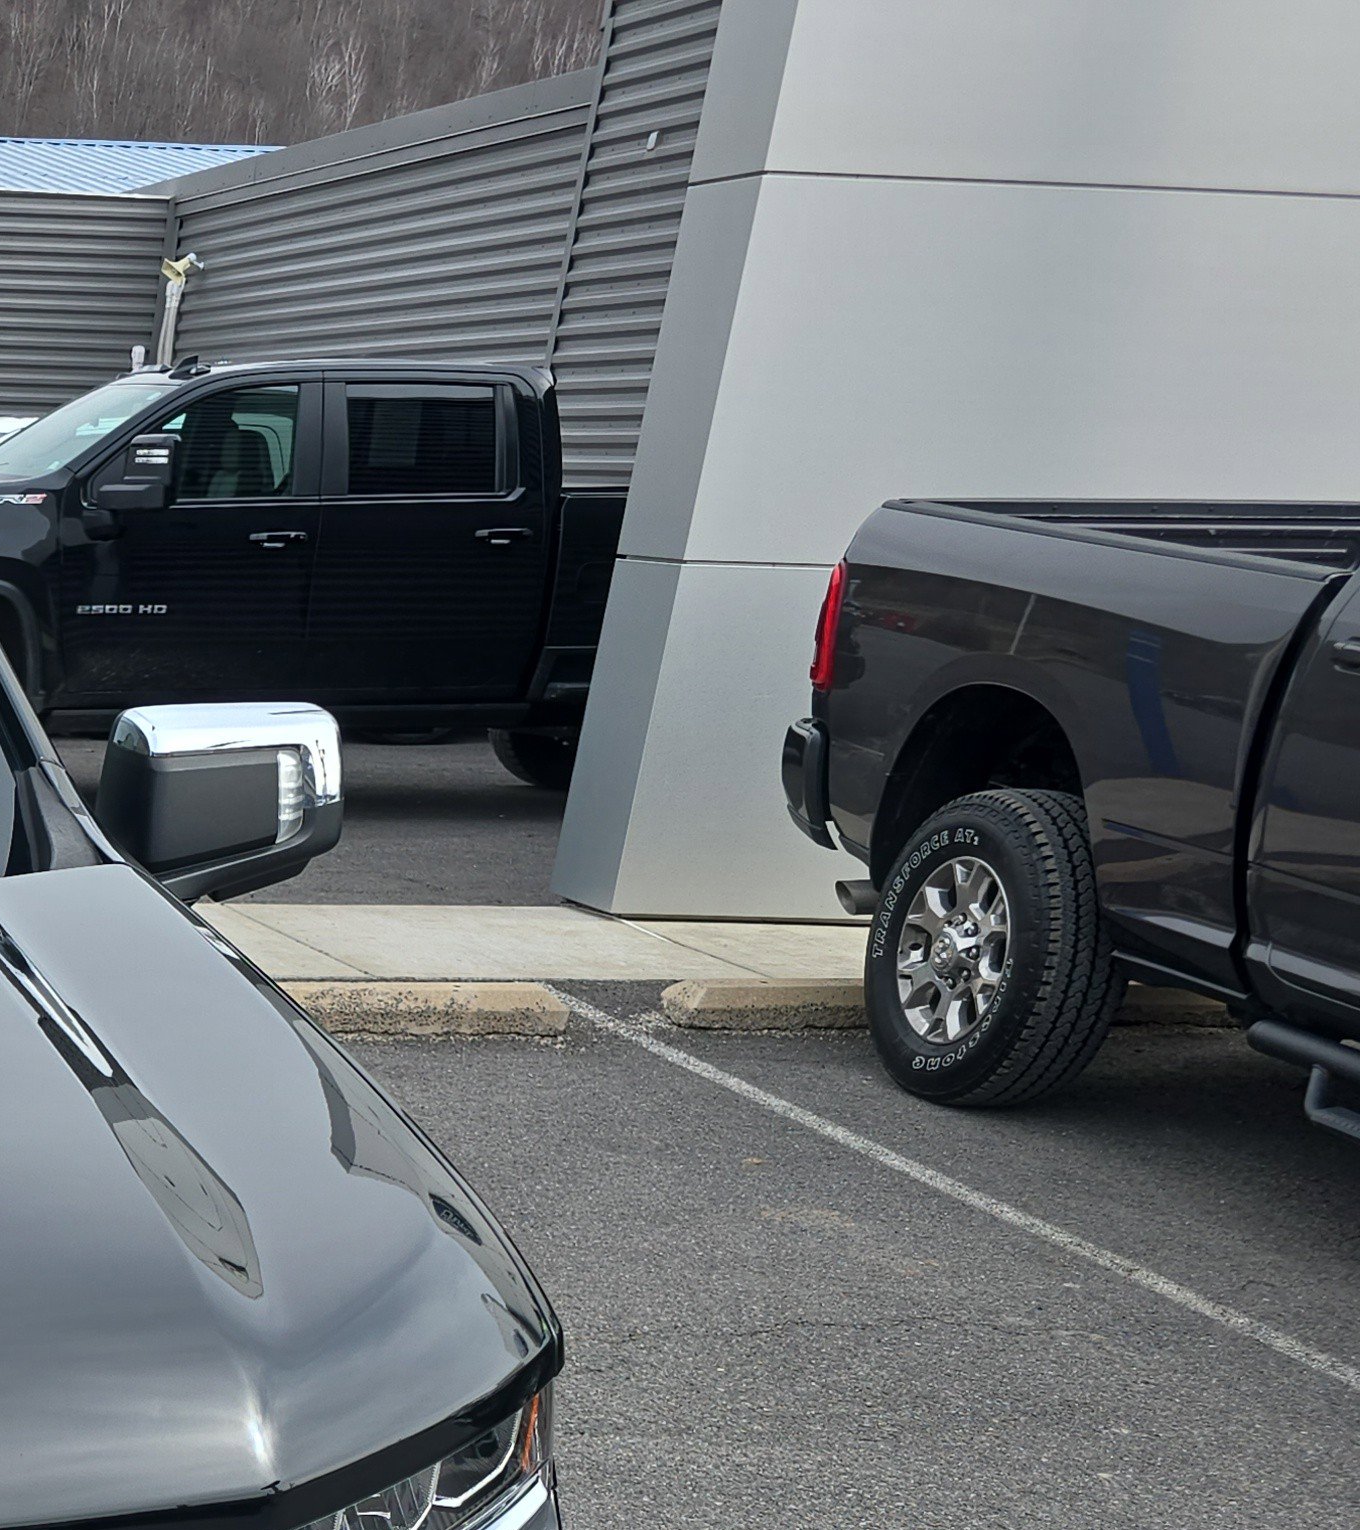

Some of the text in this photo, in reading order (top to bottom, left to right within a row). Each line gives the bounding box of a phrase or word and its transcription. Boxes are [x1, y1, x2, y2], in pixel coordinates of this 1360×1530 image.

[77, 605, 167, 614] 2500 HD
[872, 828, 949, 958] TRANSFORCE
